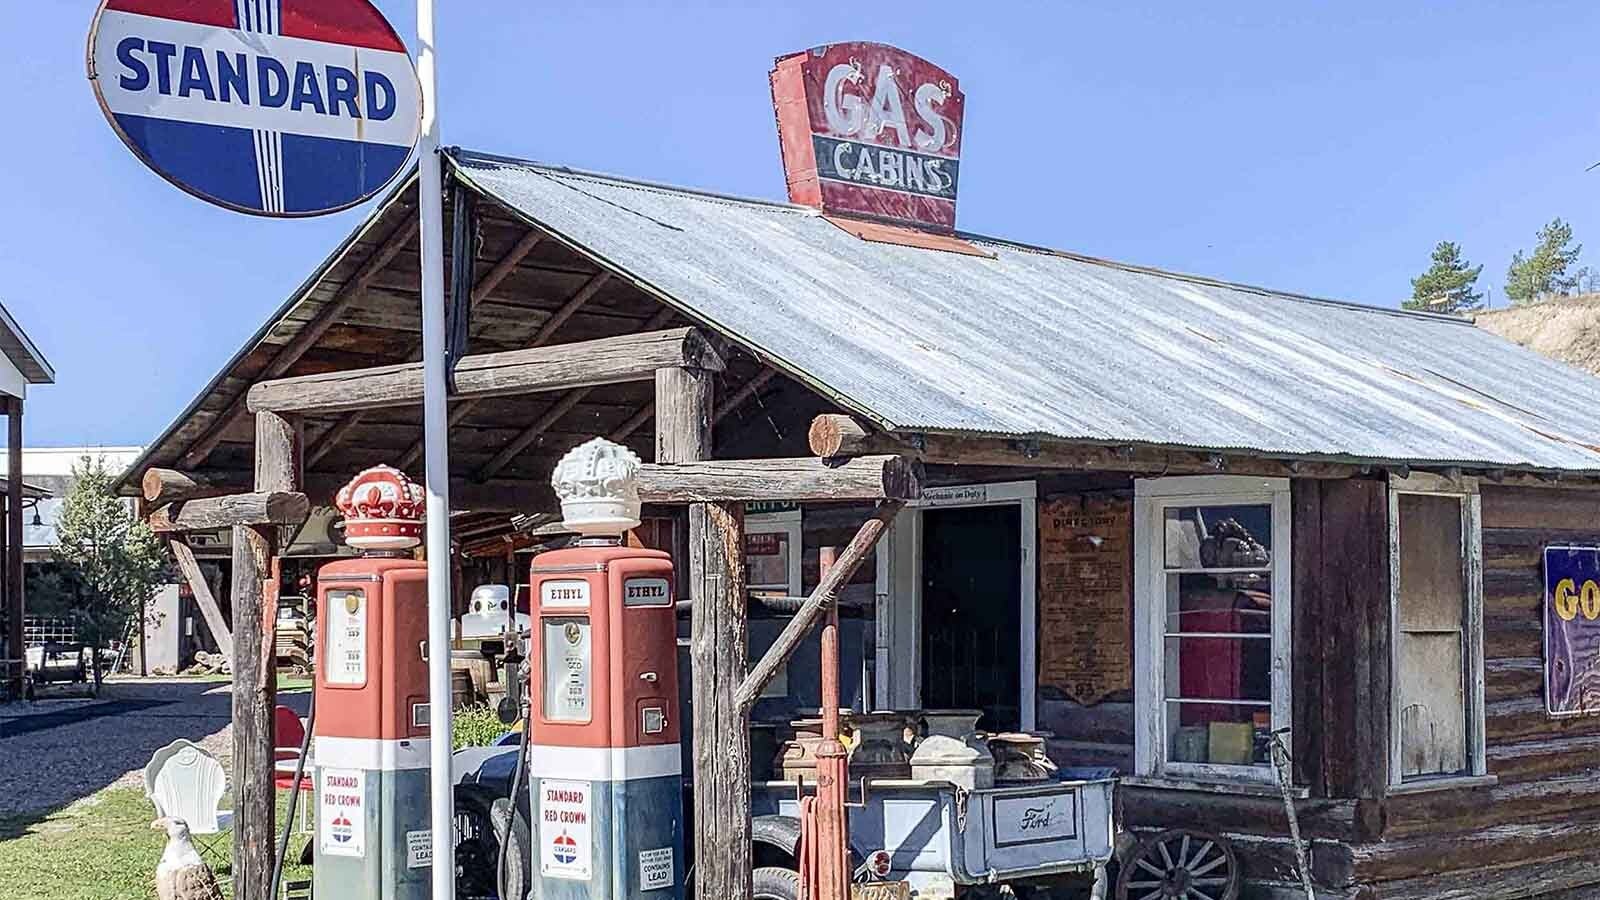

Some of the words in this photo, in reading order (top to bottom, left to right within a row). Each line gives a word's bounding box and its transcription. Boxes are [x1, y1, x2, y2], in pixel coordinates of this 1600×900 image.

[116, 36, 397, 121] STANDARD
[823, 62, 958, 152] GAS
[833, 142, 952, 192] CABINS
[551, 589, 583, 600] ETHYL
[628, 586, 664, 598] ETHYL
[327, 775, 358, 788] STANDARD
[325, 794, 336, 805] RED
[338, 795, 360, 807] CROWN
[547, 789, 583, 803] STANDARD
[545, 810, 557, 821] RED
[560, 811, 586, 824] CROWN
[1020, 807, 1050, 830] Ford
[648, 872, 667, 881] LEAD
